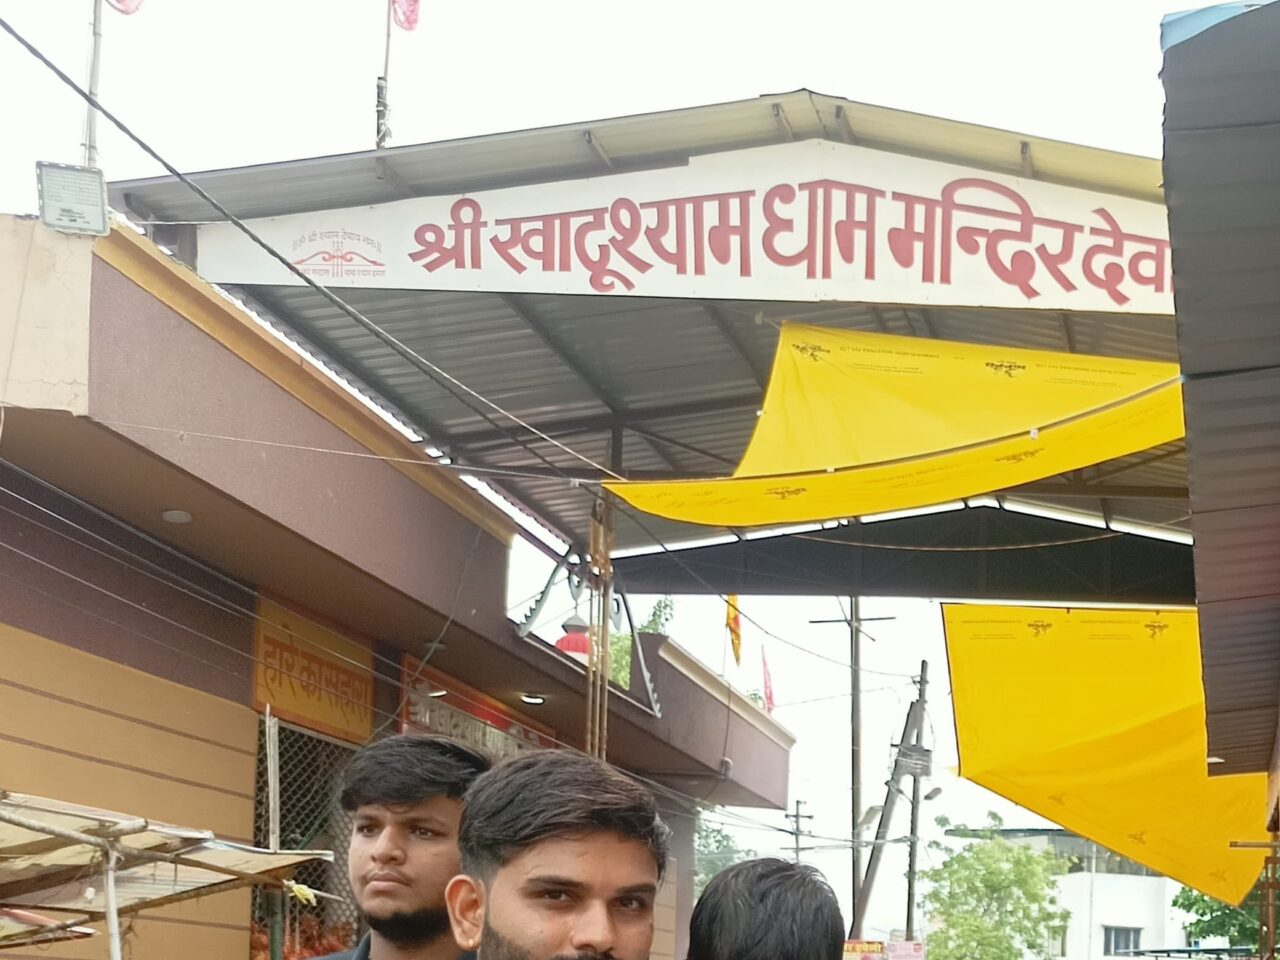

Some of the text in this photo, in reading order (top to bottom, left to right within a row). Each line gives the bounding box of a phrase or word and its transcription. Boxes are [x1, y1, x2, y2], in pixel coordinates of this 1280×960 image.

[408, 197, 488, 273] श्री
[762, 179, 886, 281] धाम
[888, 178, 1084, 299] मन्दिर
